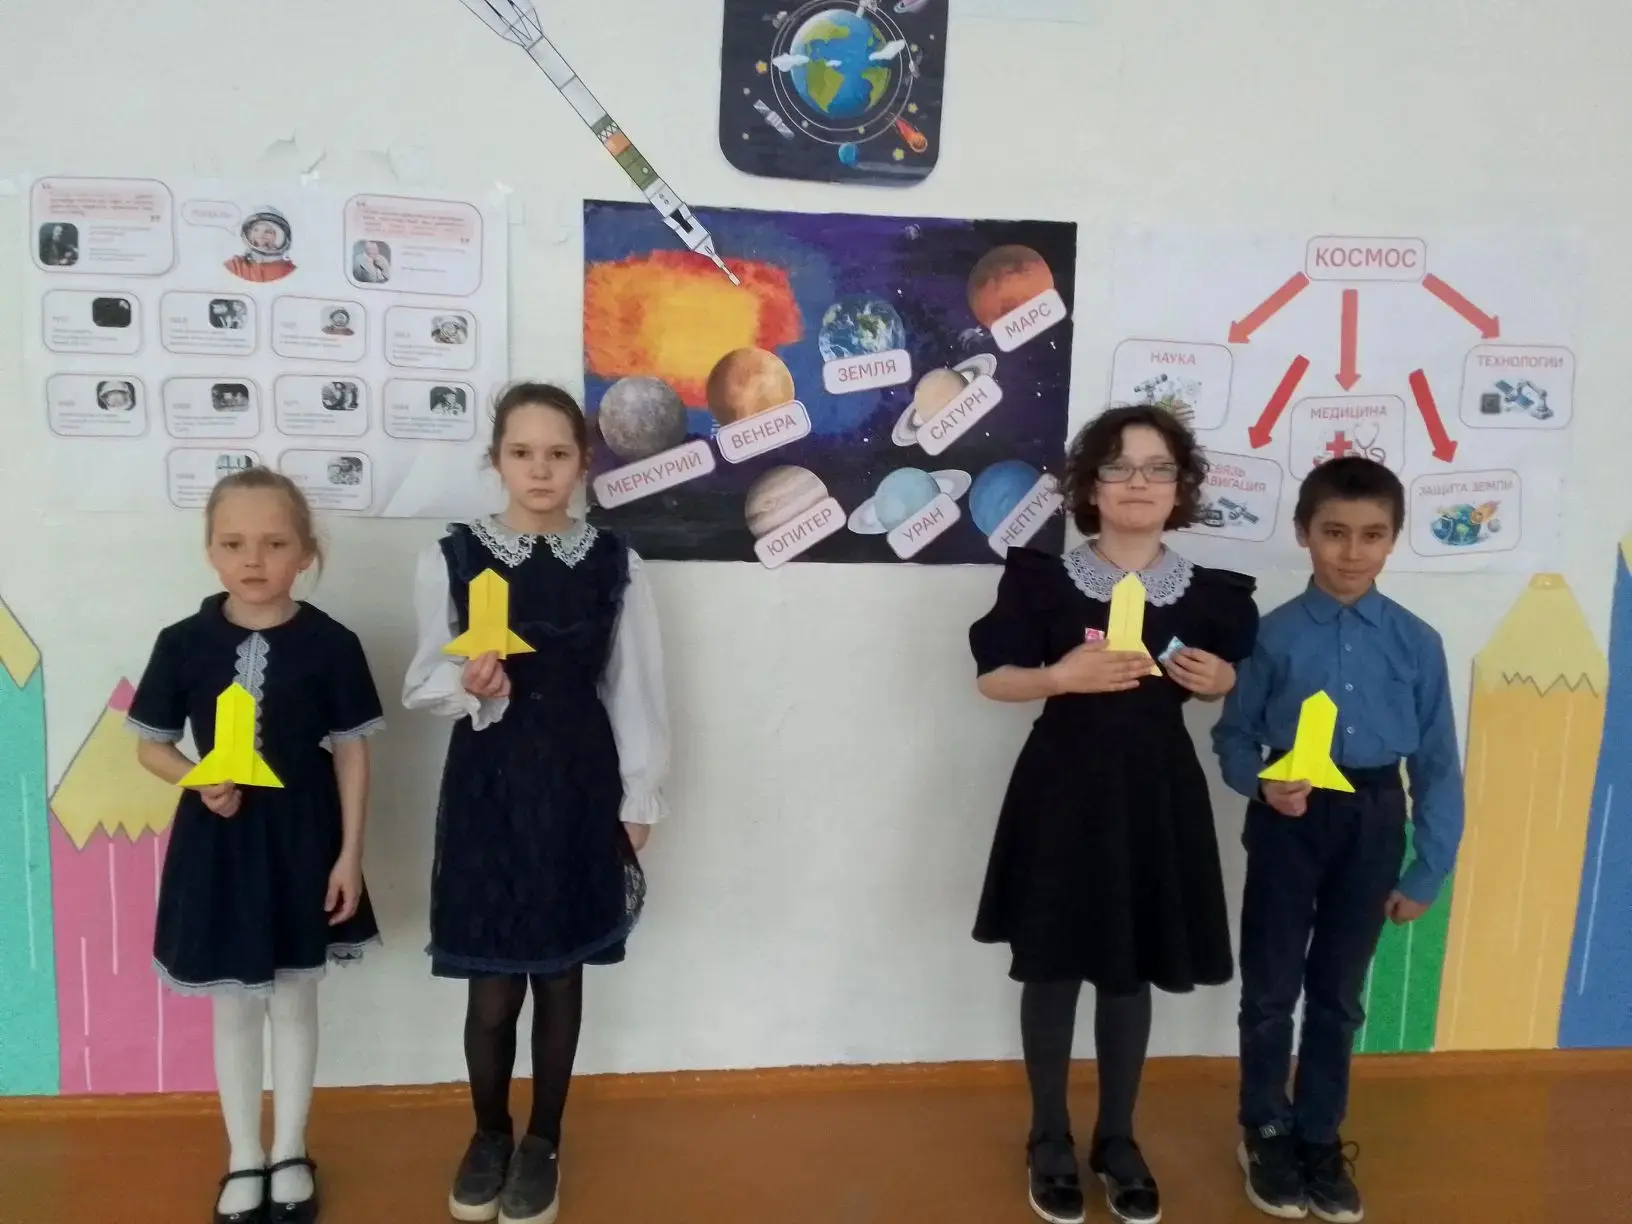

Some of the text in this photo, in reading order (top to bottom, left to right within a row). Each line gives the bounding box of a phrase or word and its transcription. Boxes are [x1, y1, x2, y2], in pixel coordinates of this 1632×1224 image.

[1314, 247, 1418, 269] КОСМОС
[1004, 301, 1054, 341] МАРС
[837, 357, 898, 384] ЗЕМЛЯ
[1150, 352, 1197, 366] НАУКА
[1477, 355, 1564, 369] ТЕХНОЛОГИИ
[929, 386, 989, 442] САТУРН
[1310, 406, 1388, 421] МЕДИЦИНА
[730, 413, 798, 450] ВЕНЕРА
[605, 448, 703, 498] МЕРКУРИЙ
[1203, 475, 1266, 493] АВИГАЦИЯ
[1419, 483, 1468, 498] ЗАЩИТА
[766, 507, 834, 558] ЮПИТЕР
[902, 507, 945, 545] УРАН
